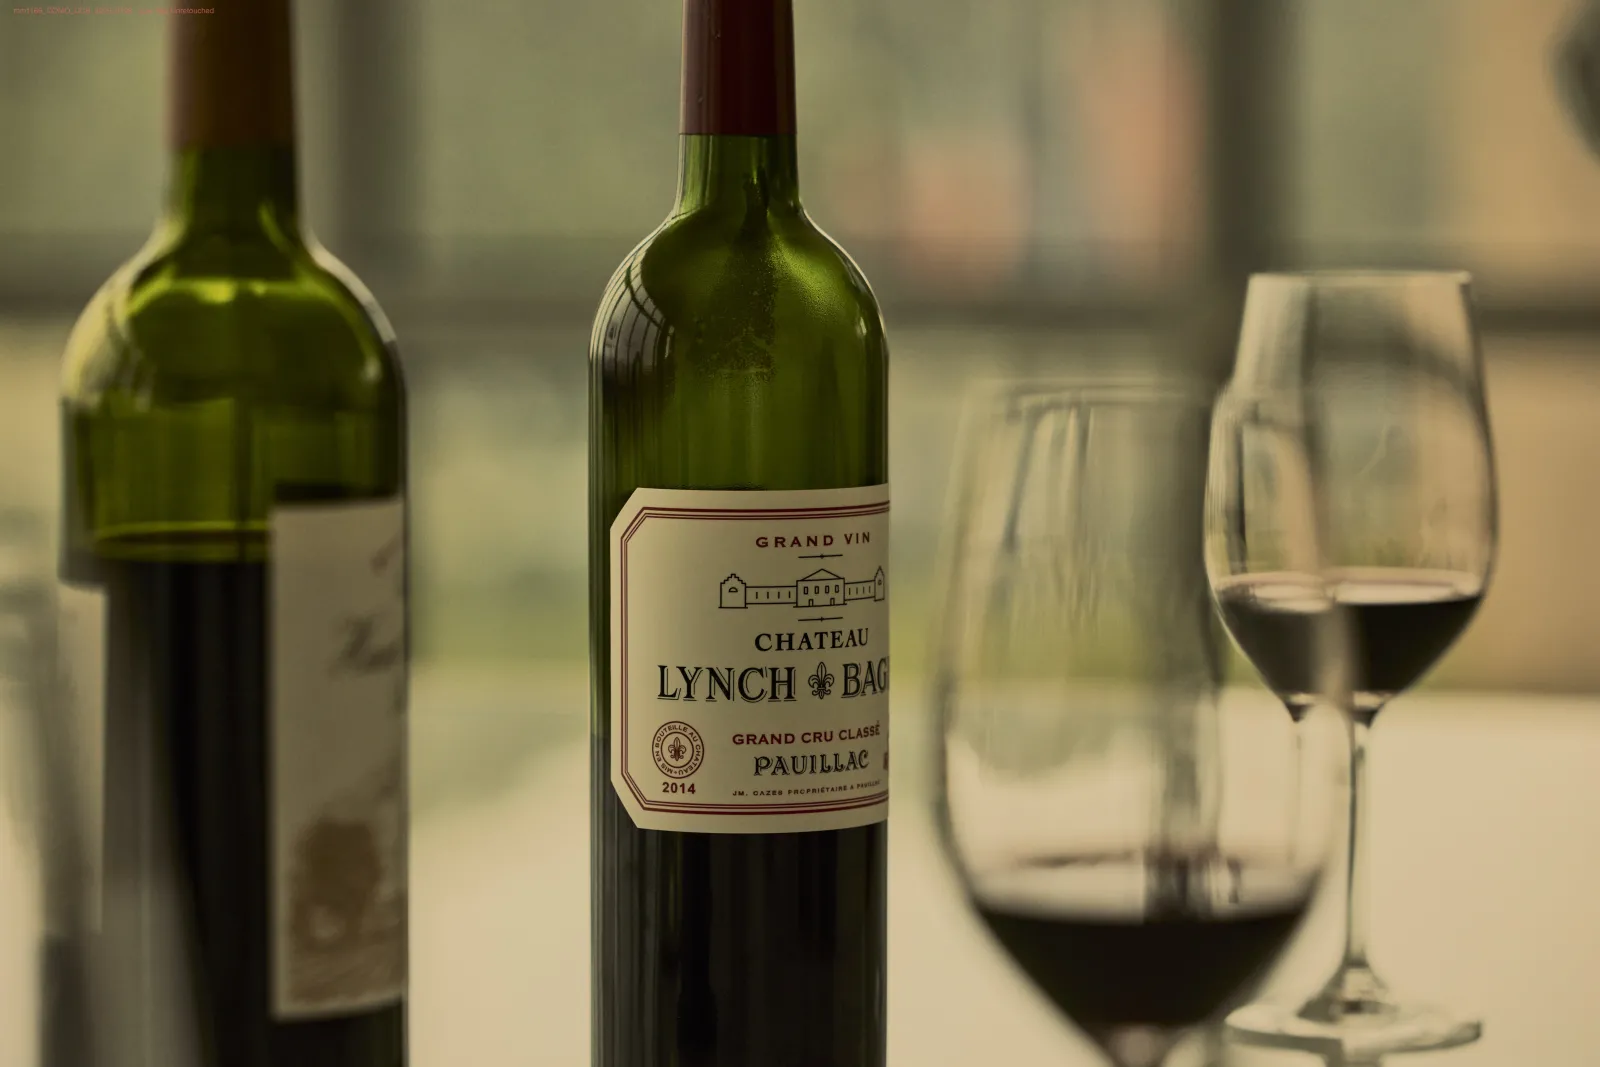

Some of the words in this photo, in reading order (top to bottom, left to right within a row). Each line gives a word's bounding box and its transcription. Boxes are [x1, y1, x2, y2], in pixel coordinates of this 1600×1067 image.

[755, 535, 834, 548] GRAND
[844, 532, 870, 545] VIN
[754, 628, 869, 652] CHATEAU
[657, 664, 798, 703] LYNCH
[841, 656, 889, 699] BAG
[654, 724, 688, 748] BOUTEILLE
[688, 731, 699, 743] AU
[732, 733, 796, 746] GRAND
[801, 730, 833, 744] CRU
[838, 720, 880, 741] CLASSÉ
[654, 750, 662, 762] EN
[753, 749, 870, 776] PAUILLAC
[660, 762, 673, 775] MIS
[662, 782, 696, 795] 2014
[787, 785, 848, 795] PROPRIÉTAIRE
